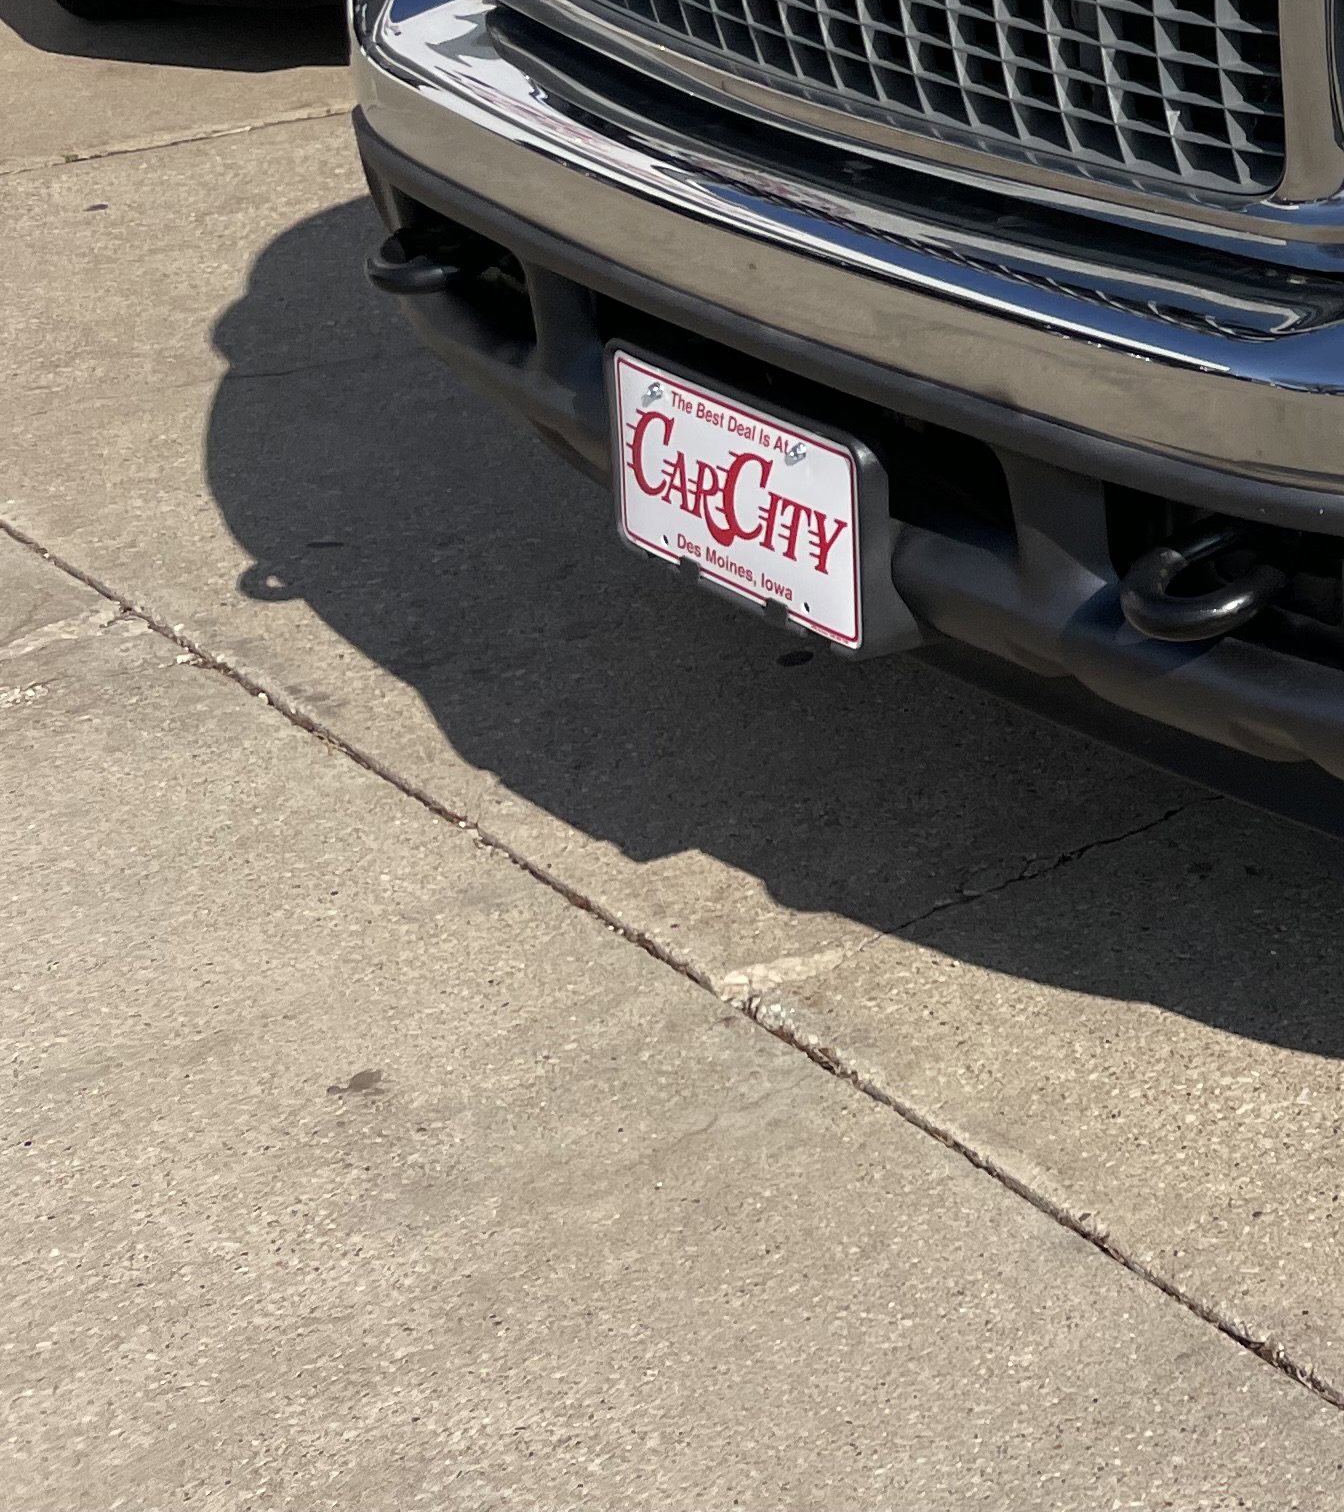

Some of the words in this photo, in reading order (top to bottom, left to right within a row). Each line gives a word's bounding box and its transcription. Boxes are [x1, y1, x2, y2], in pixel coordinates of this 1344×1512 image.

[670, 390, 694, 414] The
[696, 402, 724, 428] Best
[728, 415, 757, 441] Deal
[759, 428, 771, 448] Is
[773, 438, 789, 456] At
[676, 533, 701, 558] Des
[705, 549, 757, 587] Moines,
[761, 572, 793, 601] Iowa
